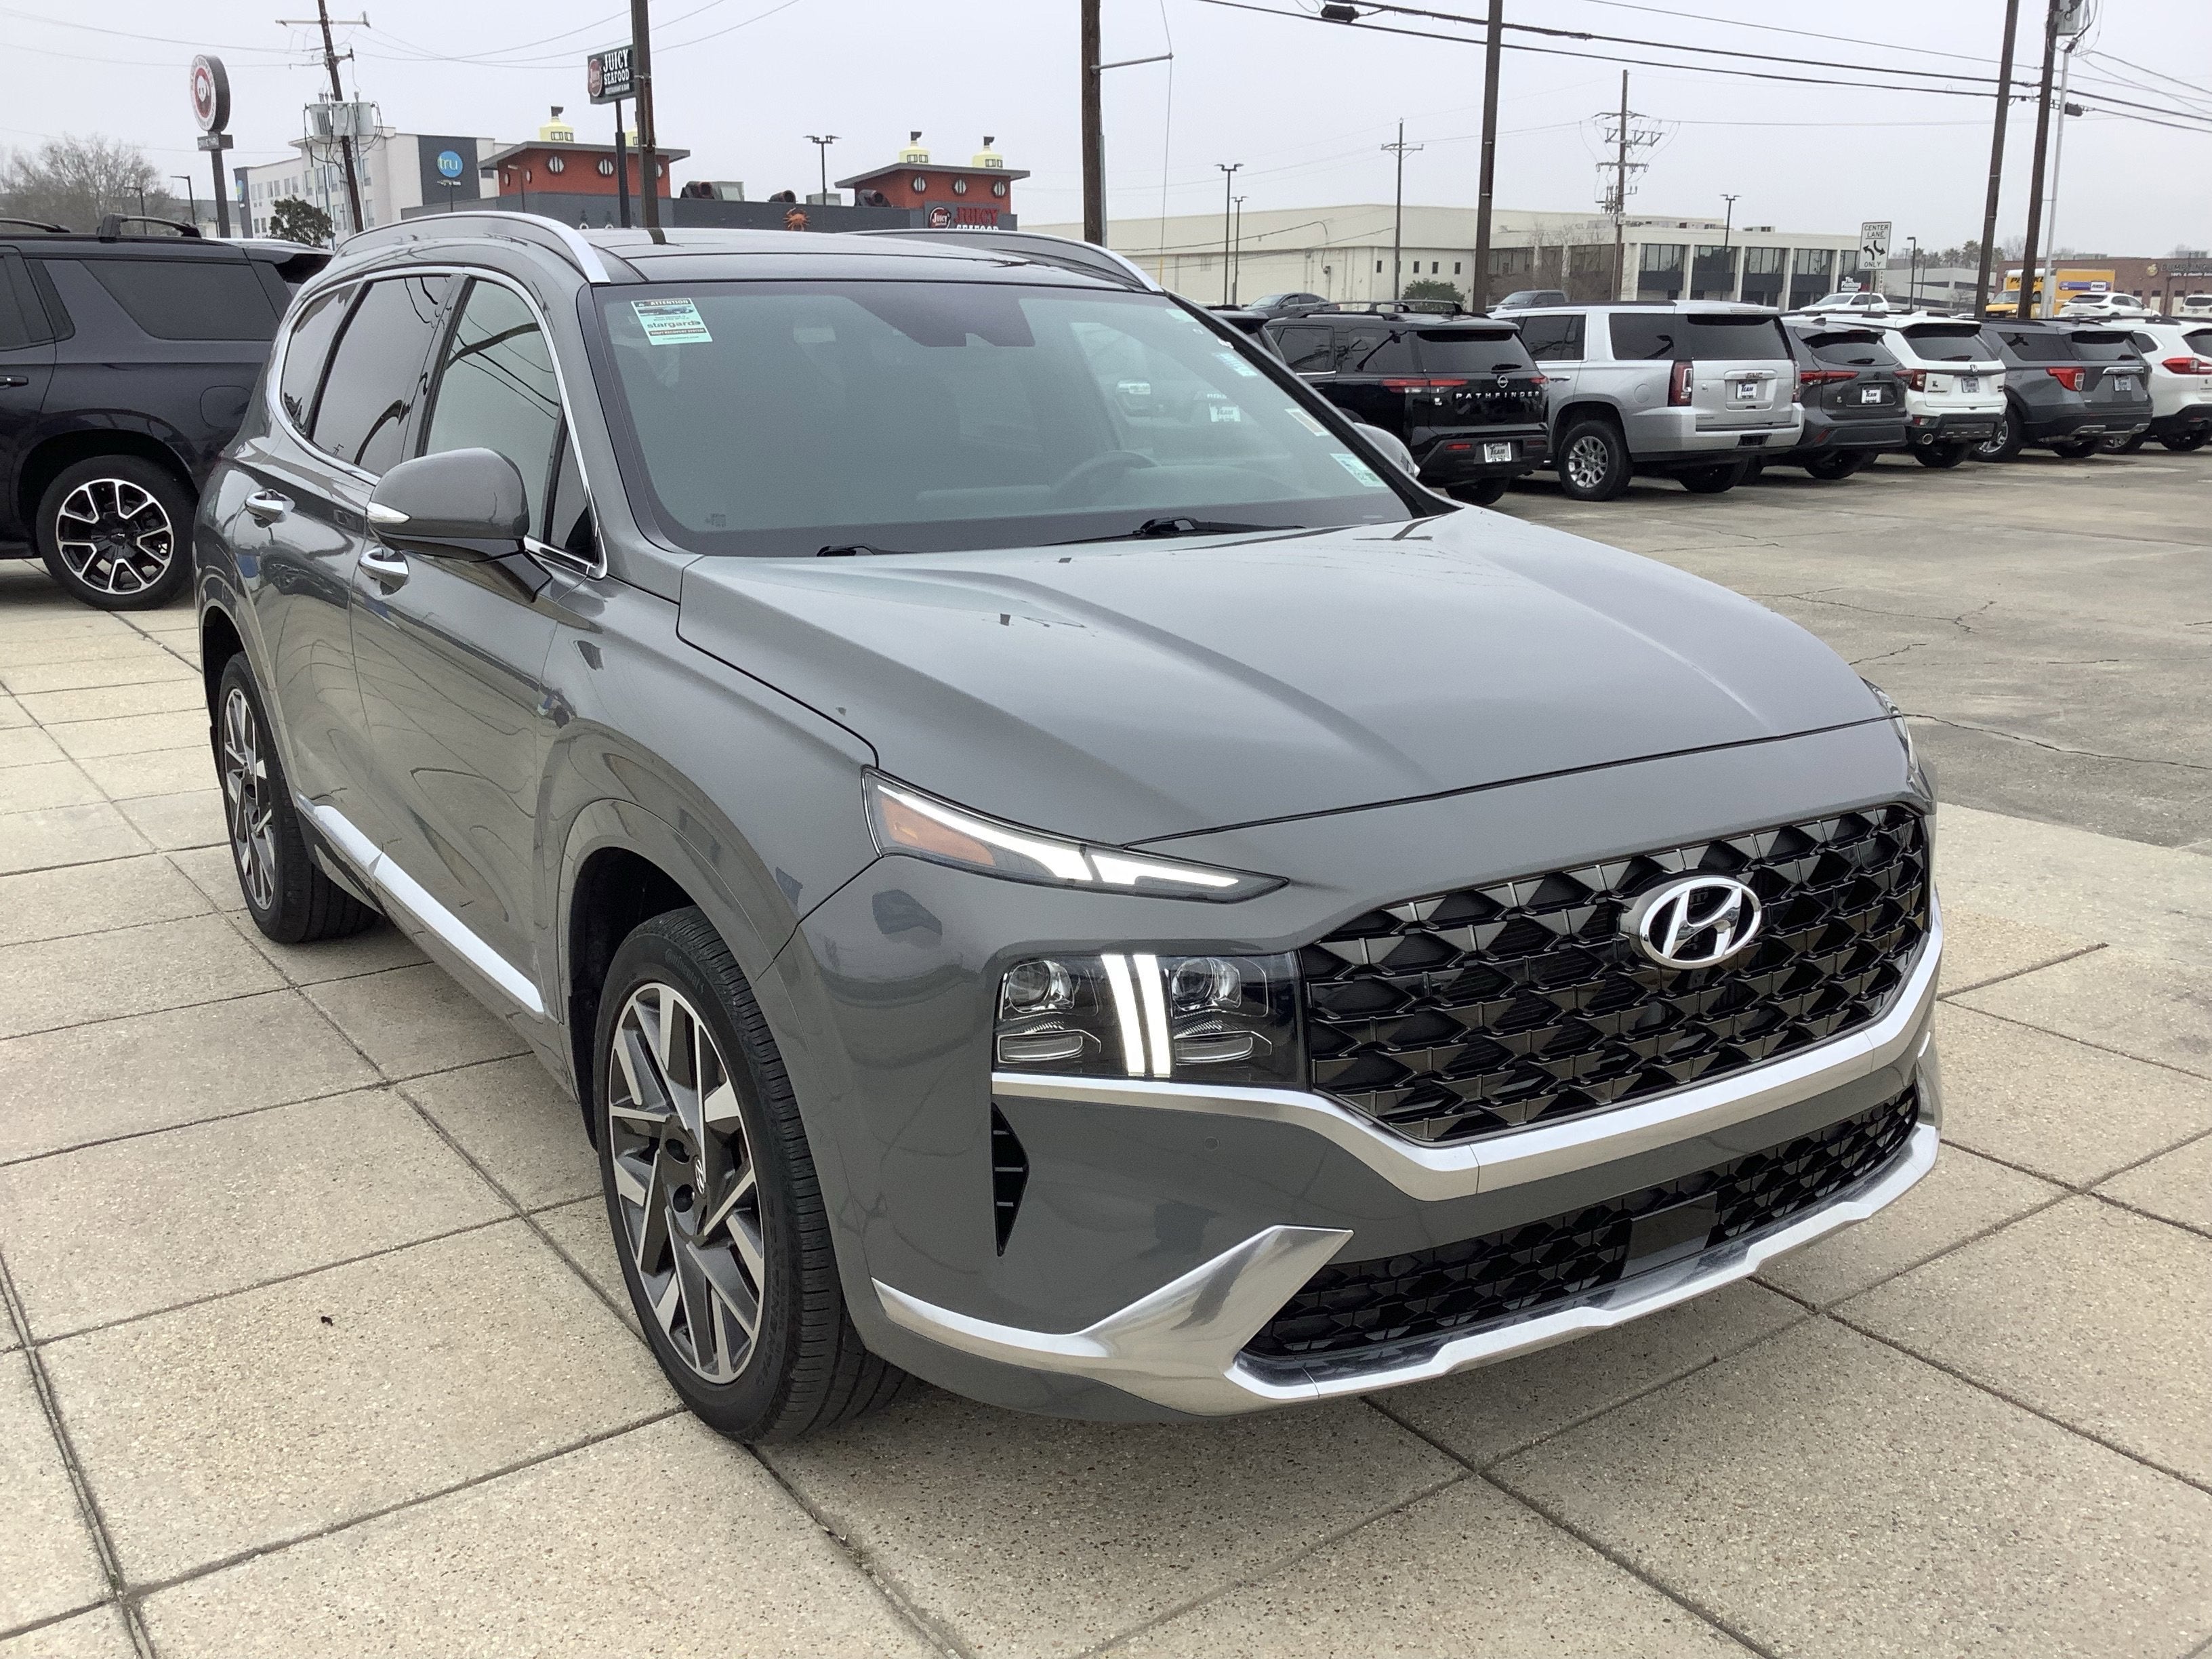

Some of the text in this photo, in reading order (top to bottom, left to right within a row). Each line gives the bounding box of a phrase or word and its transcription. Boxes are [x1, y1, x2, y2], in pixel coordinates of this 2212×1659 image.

[603, 49, 628, 73] JUICY
[603, 68, 630, 85] SEAFOOD
[438, 156, 458, 171] tru
[932, 213, 947, 224] JUICY
[954, 207, 998, 225] JUICY
[1456, 391, 1540, 399] PATHFINDER
